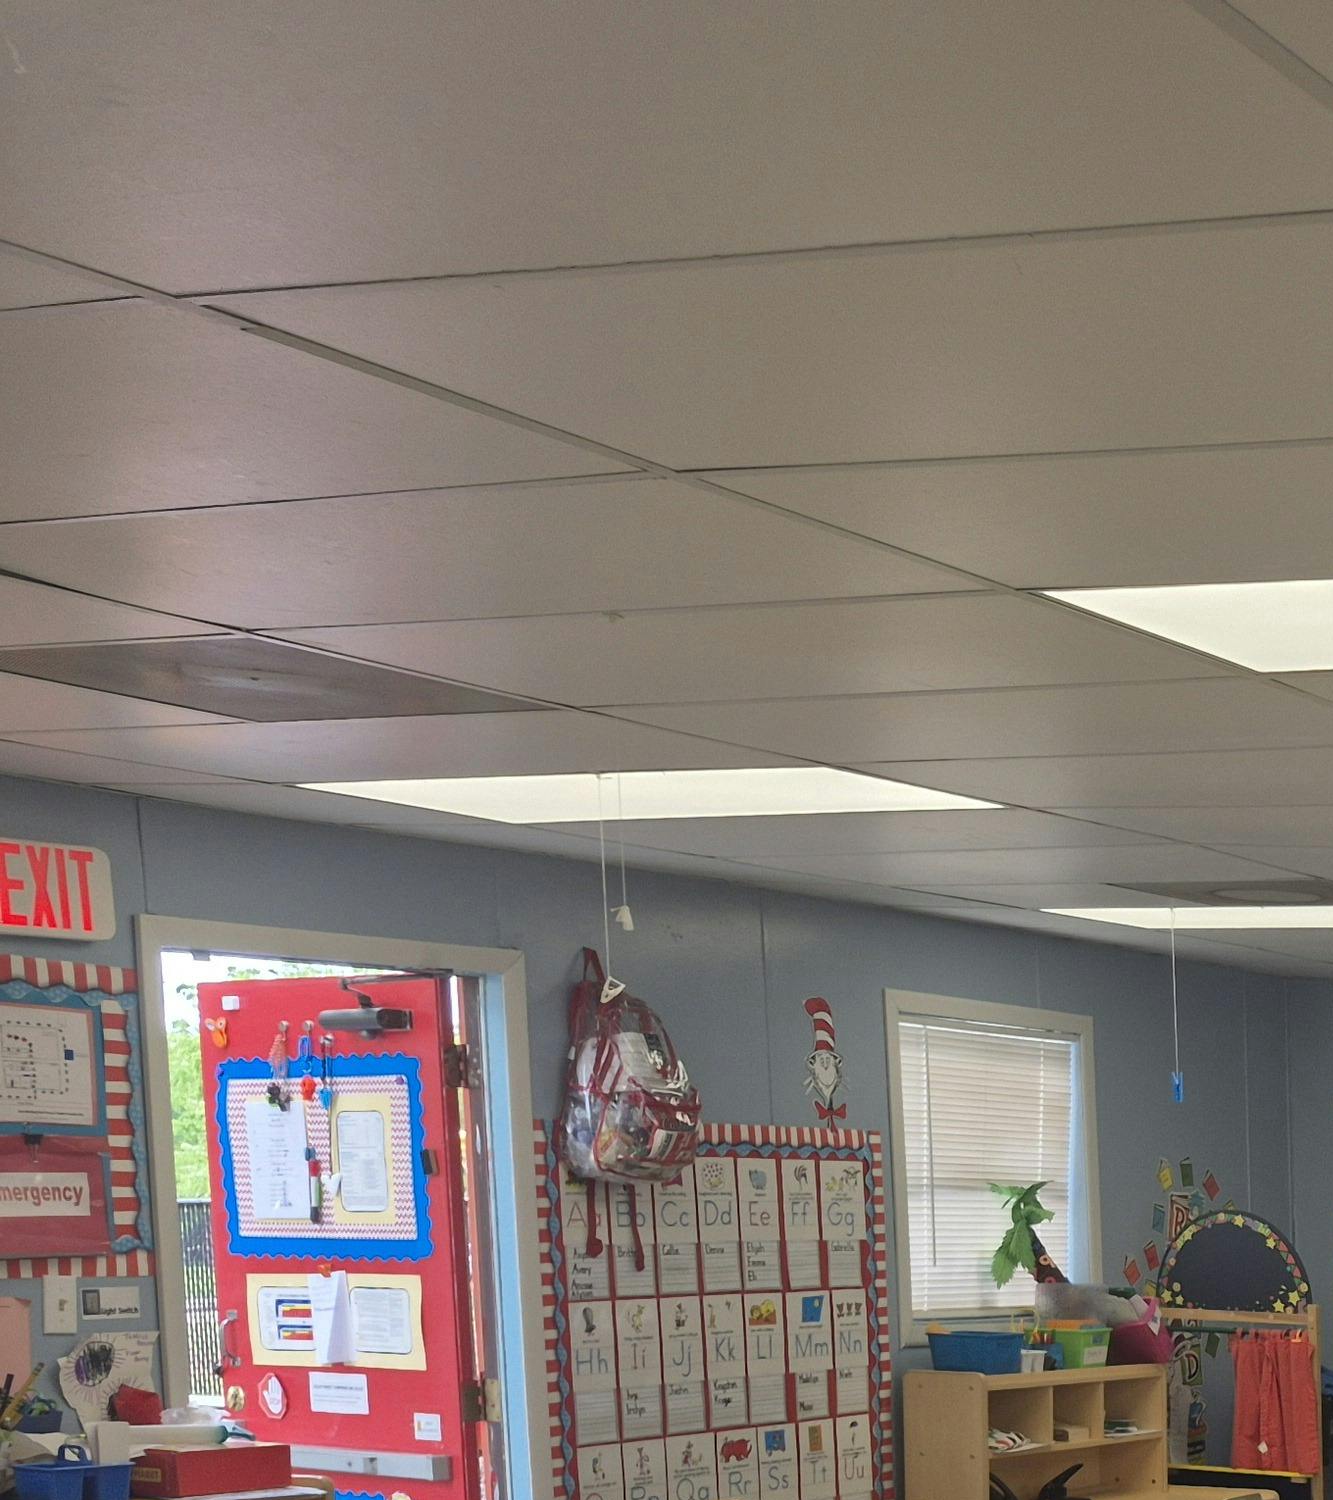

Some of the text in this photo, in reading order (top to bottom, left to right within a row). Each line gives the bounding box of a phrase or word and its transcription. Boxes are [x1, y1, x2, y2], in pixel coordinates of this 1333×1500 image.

[0, 842, 94, 932] EXIT
[0, 1185, 82, 1206] mergency
[661, 1200, 690, 1227] Cc
[704, 1200, 732, 1226] Dd
[748, 1201, 771, 1226] Ee
[791, 1201, 810, 1225] Ff
[827, 1201, 855, 1236] Gg
[672, 1340, 692, 1377] Jj
[795, 1334, 829, 1358] Mm
[576, 1348, 608, 1375] Hh
[768, 1467, 790, 1491] Ss
